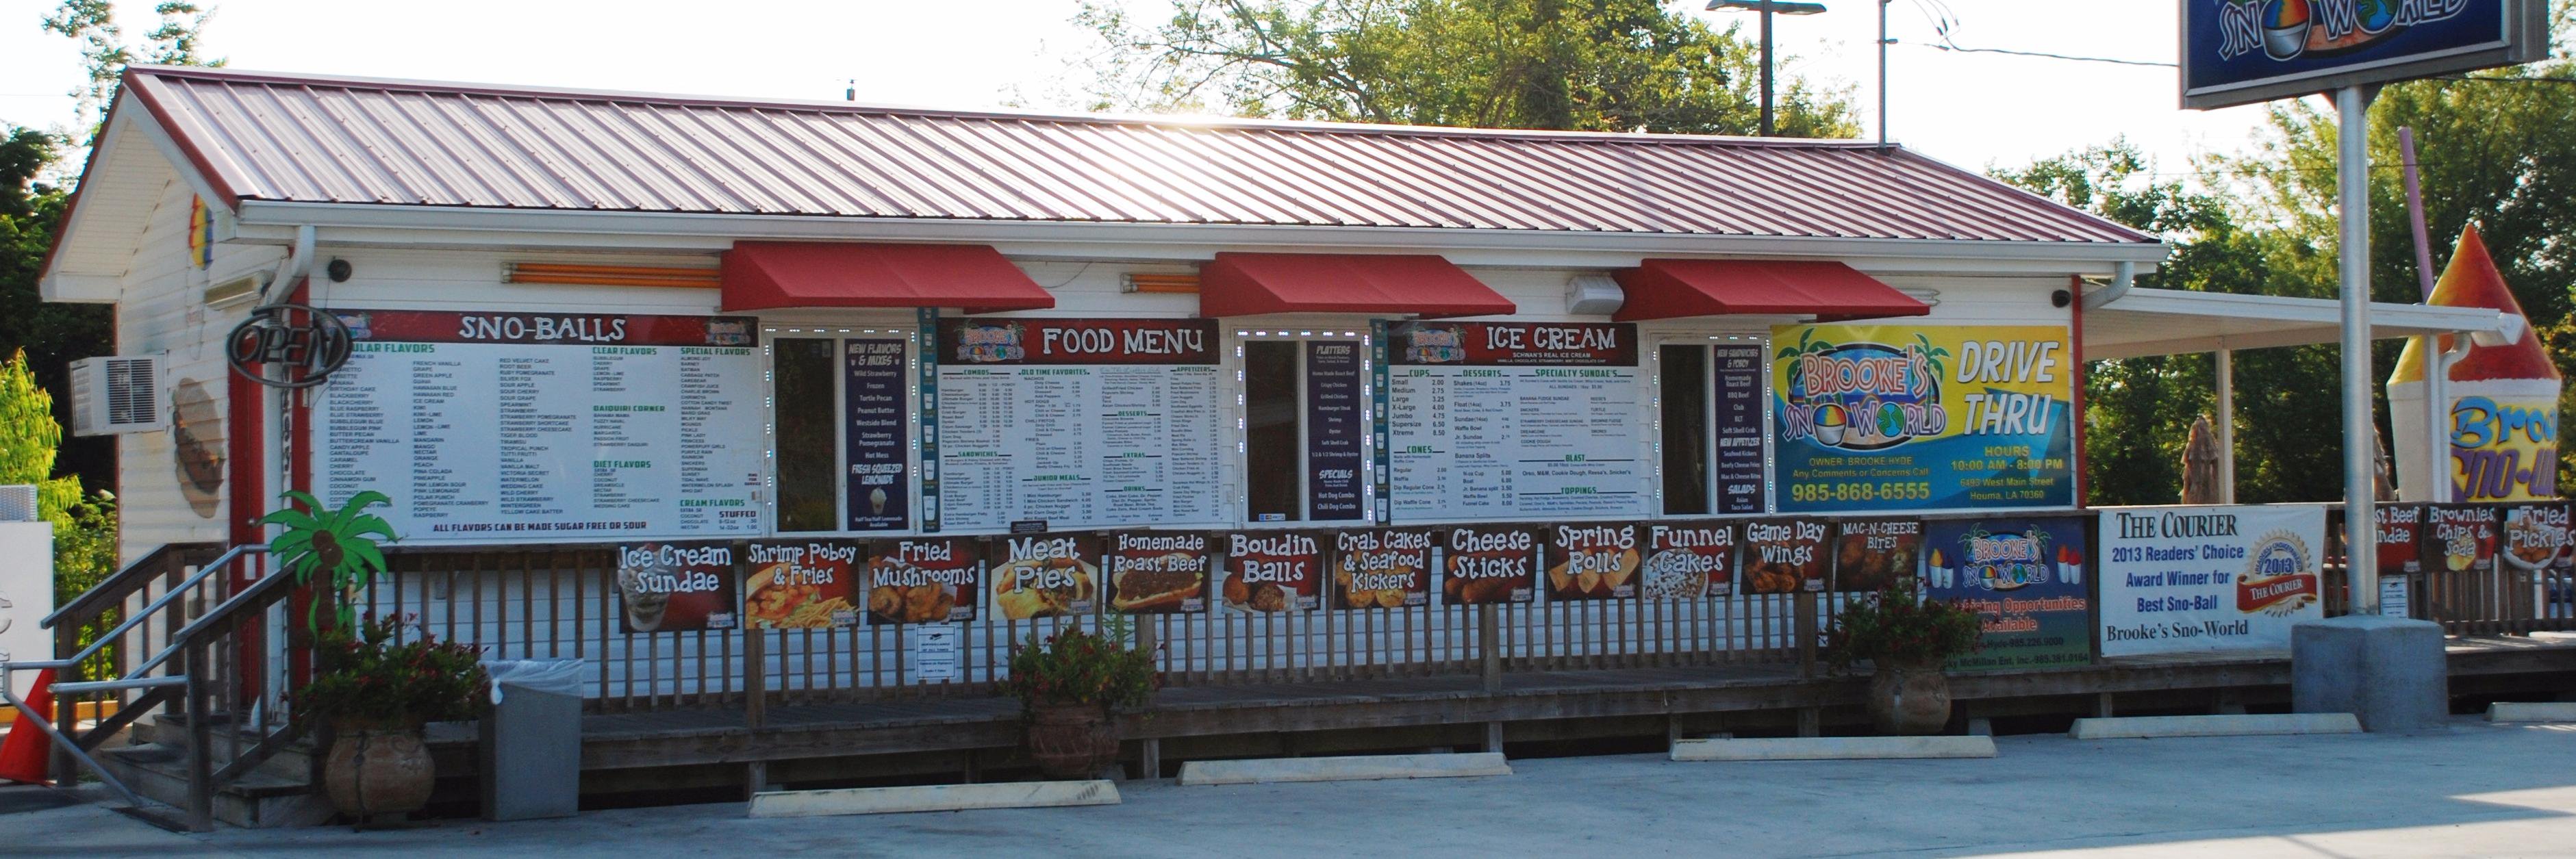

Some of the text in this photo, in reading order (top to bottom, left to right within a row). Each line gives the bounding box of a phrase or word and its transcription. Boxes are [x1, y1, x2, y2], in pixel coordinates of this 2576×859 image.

[459, 316, 626, 342] SNO-BALLS
[1487, 326, 1616, 350] ICE CREAM
[231, 324, 338, 368] OPEN
[385, 344, 435, 352] FLAVORS
[849, 344, 901, 354] NEW FLAVORS
[1043, 328, 1203, 355] FOOD MENU
[1316, 346, 1350, 355] PLATTERS
[868, 355, 892, 366] MIXES
[1800, 344, 1931, 396] BROOKE'S
[1957, 341, 2059, 383] DRIVE
[1535, 369, 1576, 377] SPECIALTY
[1852, 402, 1946, 438] WORLD
[1964, 394, 2051, 435] THRU
[1848, 457, 1912, 465] BROOKE HYDE
[1984, 446, 2030, 457] HOURS
[852, 464, 871, 474] FRESH
[1319, 470, 1353, 479] SPECIALS
[1793, 470, 1809, 479] Any
[1812, 469, 1856, 477] Comments
[1870, 468, 1910, 476] Concerns
[1952, 459, 2063, 471] 10:00 AM 8:00 PM
[1728, 484, 1756, 494] SALADS
[1792, 482, 1930, 502] 985-868-6555
[1983, 478, 2004, 487] West
[2006, 478, 2027, 486] Main
[2116, 511, 2239, 539] THE COURIER
[2390, 507, 2420, 524] Beef
[2517, 504, 2569, 526] Fried
[1452, 528, 1531, 552] Cheese
[1556, 525, 1635, 550] Spring
[1651, 525, 1733, 548] Funnel
[1746, 520, 1826, 543] Game Day
[1842, 522, 1918, 536] MAC-N-CHEESE
[2437, 523, 2488, 541] Chips &
[2510, 525, 2576, 550] Pickles
[1008, 536, 1081, 563] Meat
[1118, 534, 1204, 551] Homemade
[1230, 534, 1319, 559] Boudin
[1337, 530, 1432, 551] Crab Cakes
[1867, 536, 1897, 548] BITES
[1972, 530, 2039, 563] BROOKE'S
[2444, 541, 2476, 556] Soda
[620, 545, 732, 569] Ice Cream
[748, 543, 857, 565] Shrimp Poboy
[898, 541, 951, 563] Fried
[1343, 550, 1424, 572] & Seafood
[1658, 551, 1725, 574] Cakes
[1760, 545, 1813, 567] Wings
[2112, 547, 2141, 562] 2013
[2145, 546, 2198, 561] Readers'
[2202, 544, 2244, 559] Choice
[1113, 555, 1207, 573] Roast Beef
[1242, 559, 1305, 584] Balls
[1453, 555, 1527, 580] Sticks
[1566, 551, 1622, 576] Rolls
[2264, 558, 2294, 574] 2013
[635, 569, 719, 593] Sundae
[774, 565, 833, 586] & Fries
[873, 565, 975, 589] Mushrooms
[1013, 565, 1076, 594] Pies
[1350, 570, 1415, 593] Kickers
[2125, 571, 2230, 587] Award Winner for
[2250, 579, 2303, 600] THE COURIER
[2003, 595, 2086, 615] Opportunities
[2136, 595, 2217, 613] Best Sno-Ball
[1982, 617, 2038, 633] Available
[2106, 619, 2248, 642] Brooke's Sno-World
